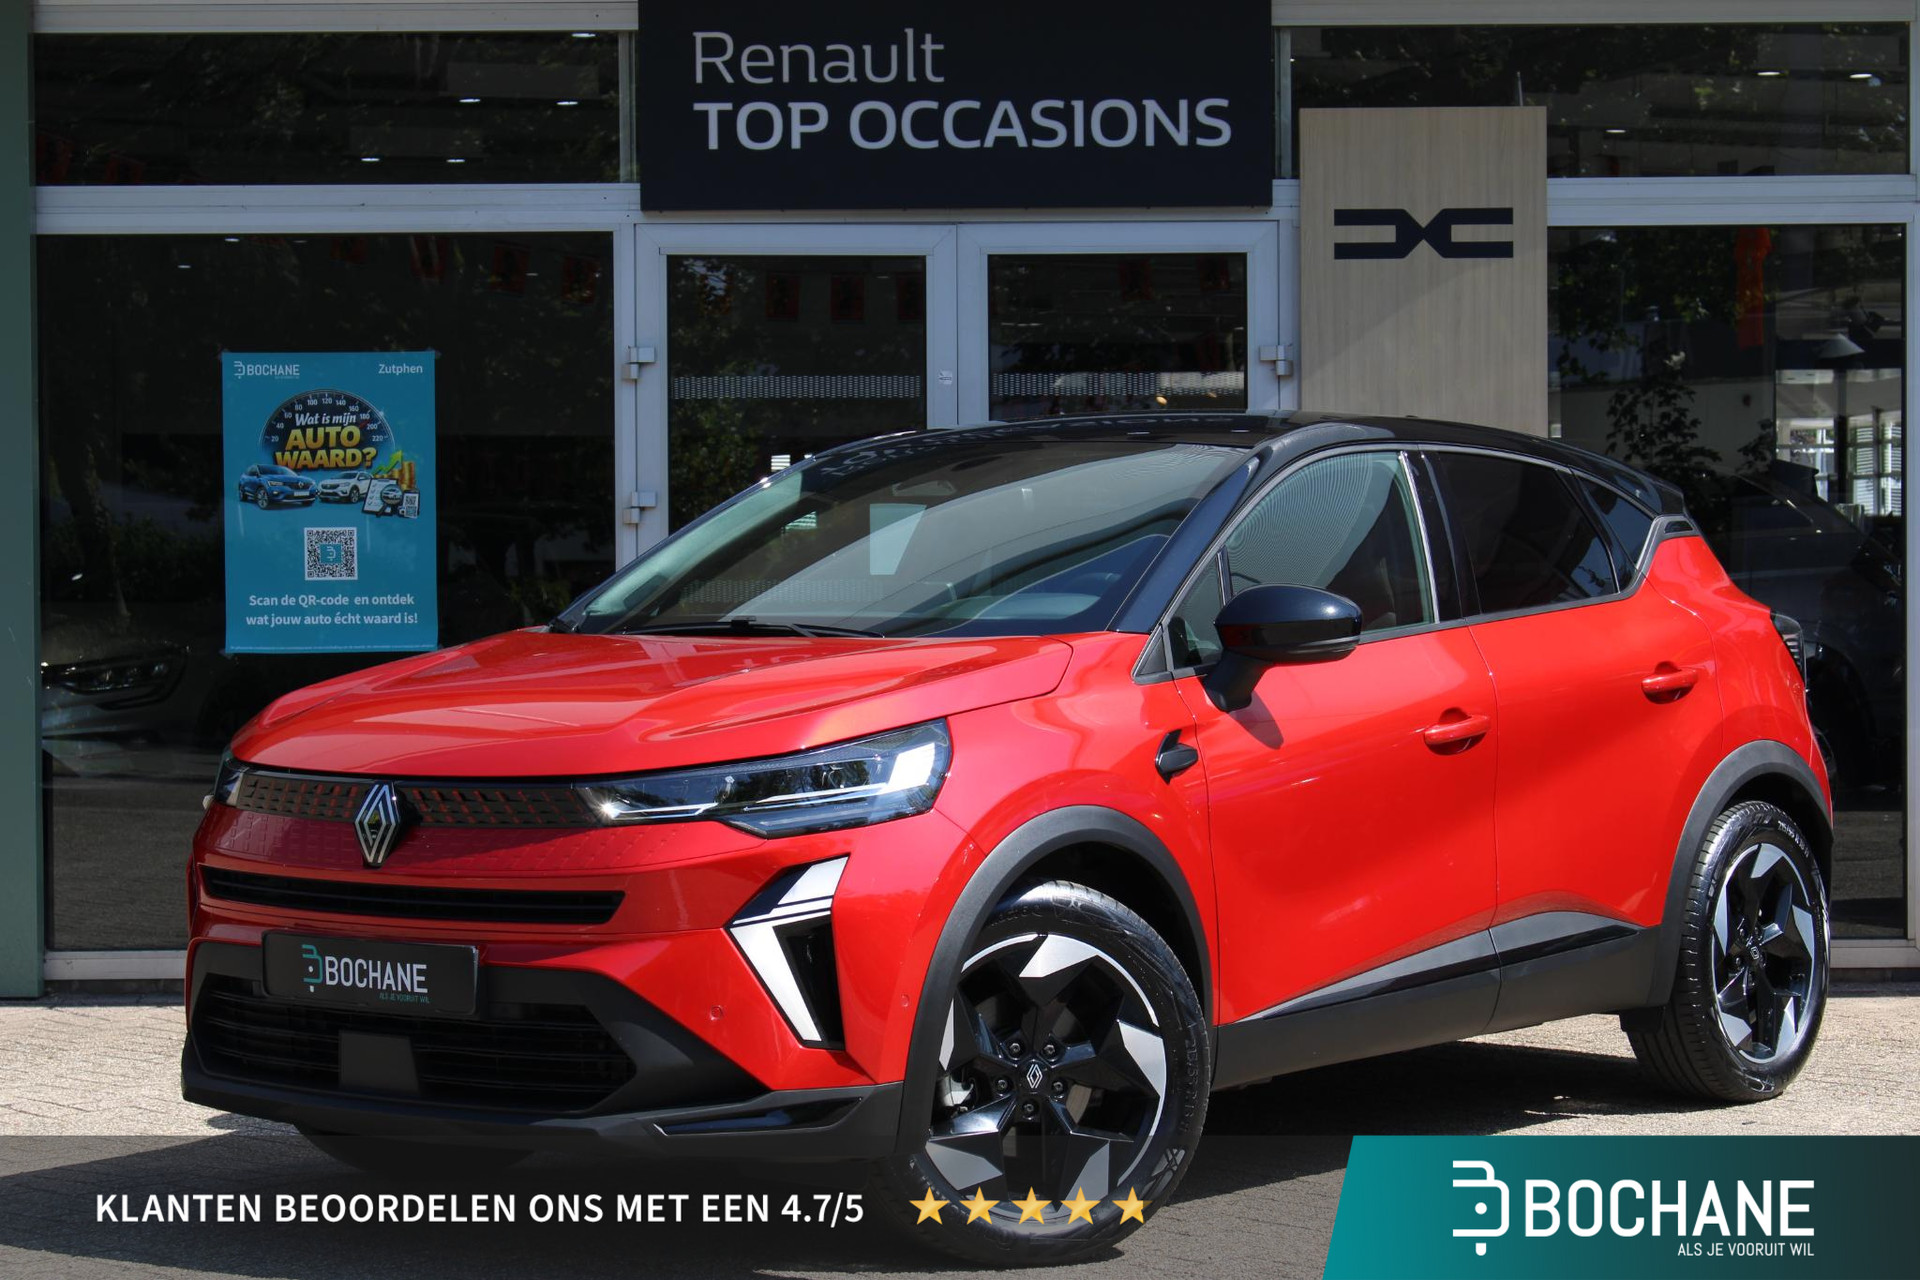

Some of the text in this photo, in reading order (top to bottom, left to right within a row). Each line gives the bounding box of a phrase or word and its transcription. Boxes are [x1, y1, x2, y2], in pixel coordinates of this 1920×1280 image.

[693, 28, 945, 84] Renault
[693, 98, 1232, 150] TOP OCCASIONS
[247, 364, 300, 376] BOCHANE
[378, 363, 423, 376] Zutphen
[295, 412, 356, 426] Wat is mijn
[285, 426, 361, 450] AUTO
[275, 447, 377, 468] WAARD?
[249, 594, 414, 608] Scan de QR-code en ontdek
[246, 612, 418, 628] wat jouw auto écht waard is!
[325, 956, 428, 993] BOCHANE
